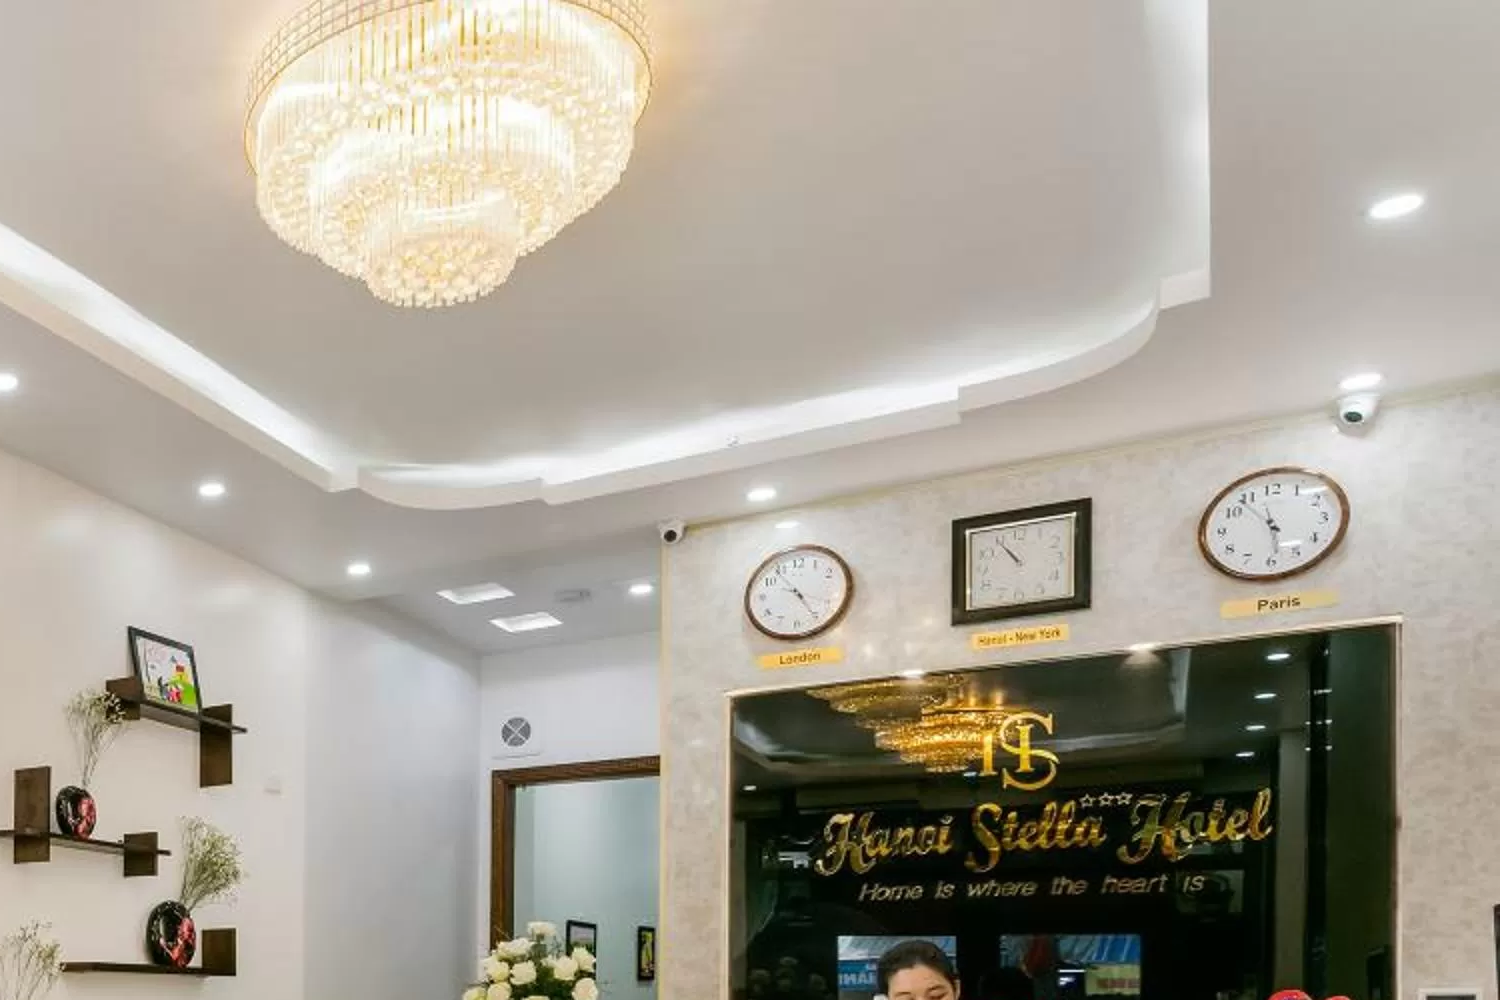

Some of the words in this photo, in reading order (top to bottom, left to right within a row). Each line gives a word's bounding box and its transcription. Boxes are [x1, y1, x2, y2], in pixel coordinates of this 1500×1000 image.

[1265, 483, 1281, 496] 12
[1226, 506, 1242, 519] 10
[1257, 596, 1301, 611] Paris
[1015, 631, 1037, 643] New
[1039, 627, 1062, 639] York
[779, 651, 821, 666] London
[814, 811, 955, 876] Hanoi
[964, 801, 1108, 873] Stella
[1116, 787, 1273, 865] Hotel
[858, 882, 925, 901] Home
[935, 879, 956, 899] is
[967, 878, 1039, 898] where
[1051, 875, 1089, 896] the
[1101, 872, 1169, 894] heart
[1182, 874, 1206, 893] is
